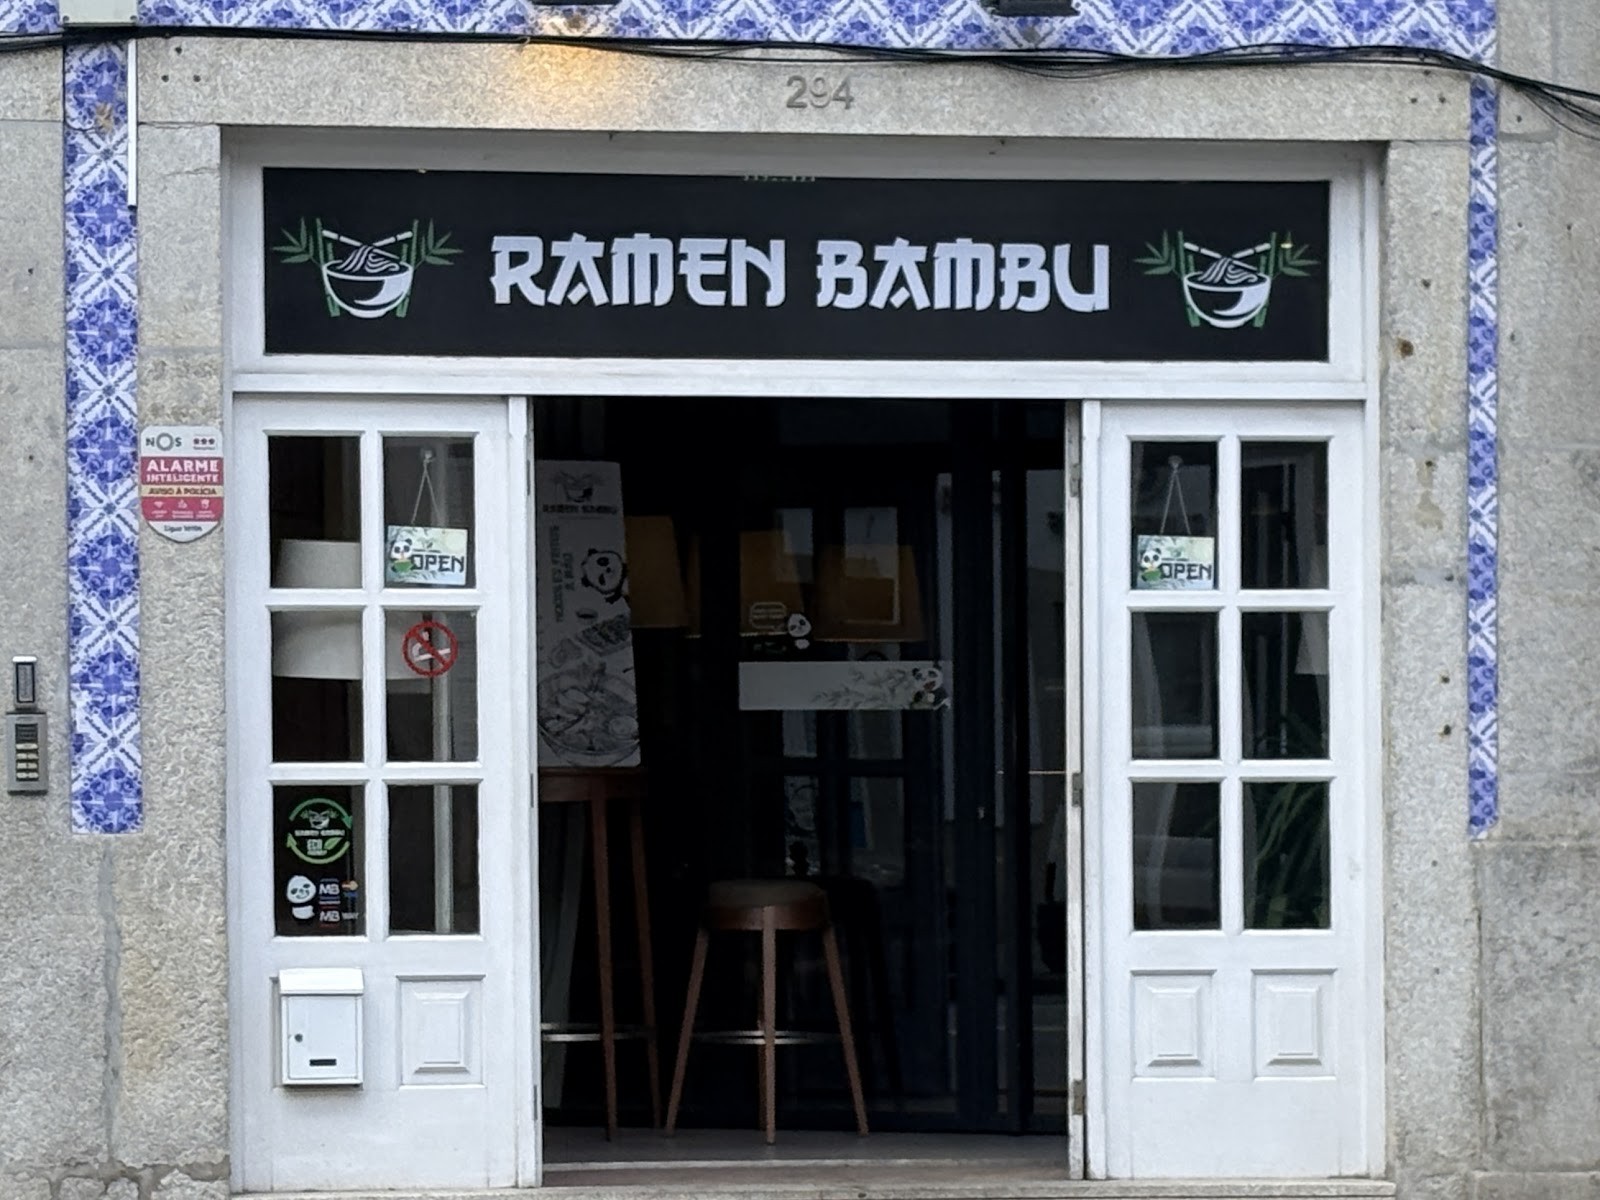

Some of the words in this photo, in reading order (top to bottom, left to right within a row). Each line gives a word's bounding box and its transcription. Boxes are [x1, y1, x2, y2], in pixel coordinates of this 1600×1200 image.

[785, 74, 855, 110] 294
[490, 232, 786, 307] RAMEN
[816, 236, 1110, 312] BAMBU
[145, 433, 182, 451] NOS
[146, 459, 219, 472] ALARME
[411, 554, 465, 573] OPEN
[1160, 563, 1212, 580] OPEN
